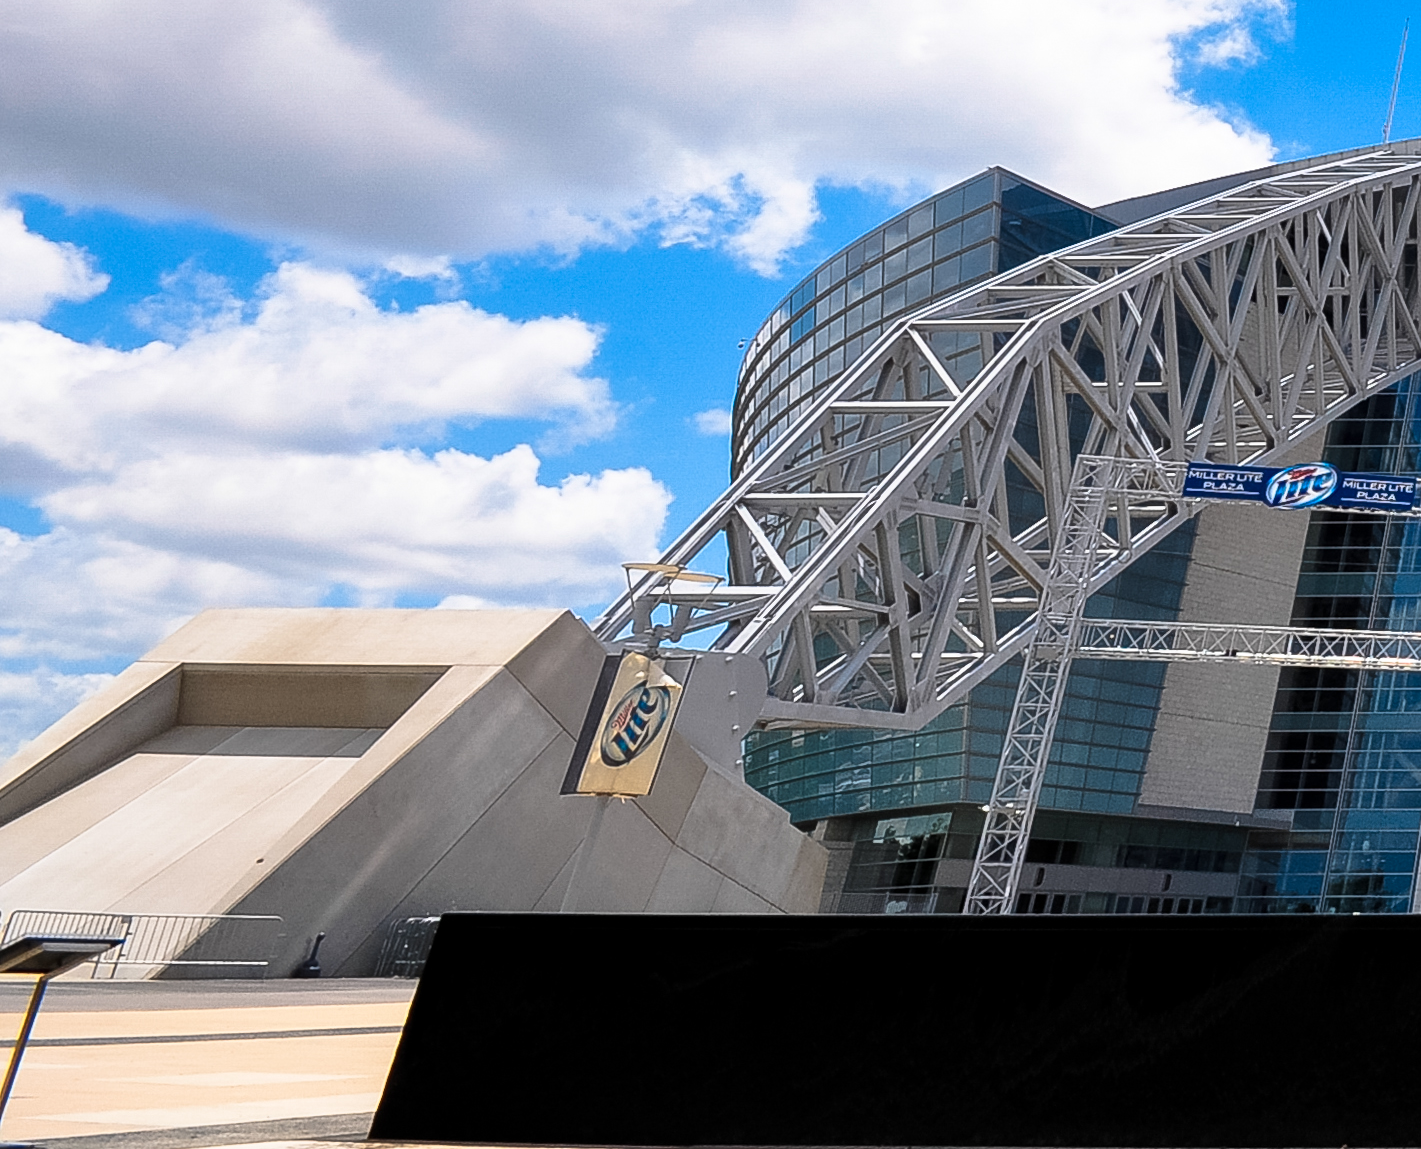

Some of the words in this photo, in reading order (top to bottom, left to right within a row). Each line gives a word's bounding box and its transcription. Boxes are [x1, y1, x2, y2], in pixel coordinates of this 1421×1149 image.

[1188, 471, 1235, 481] MILLER
[1237, 473, 1264, 483] LITE
[1203, 481, 1245, 491] PLAZA
[1342, 480, 1387, 491] MILLER
[1388, 484, 1414, 493] LITE
[1356, 491, 1396, 501] PLAZA
